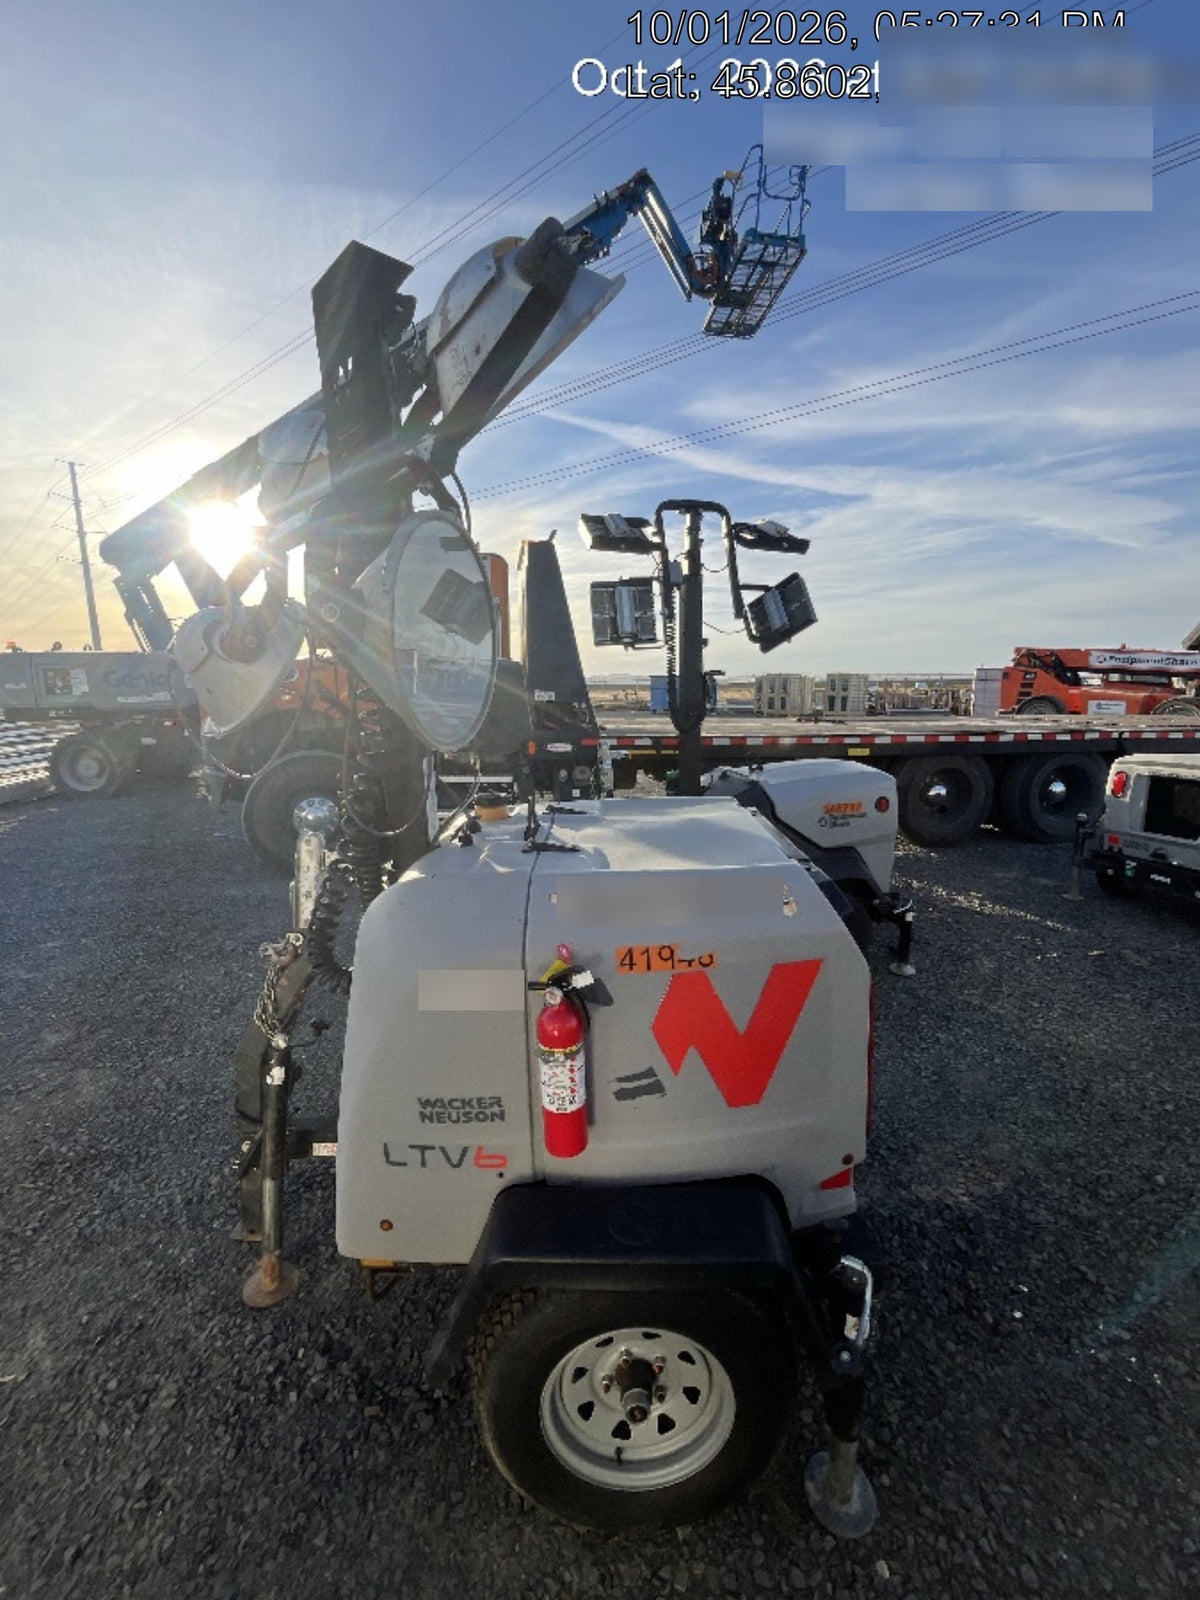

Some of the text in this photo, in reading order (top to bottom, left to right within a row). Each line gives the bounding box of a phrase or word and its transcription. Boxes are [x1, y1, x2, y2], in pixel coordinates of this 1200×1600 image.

[417, 1096, 504, 1110] WACKER
[419, 1109, 506, 1124] NEUSON
[383, 1142, 508, 1169] LTV6
